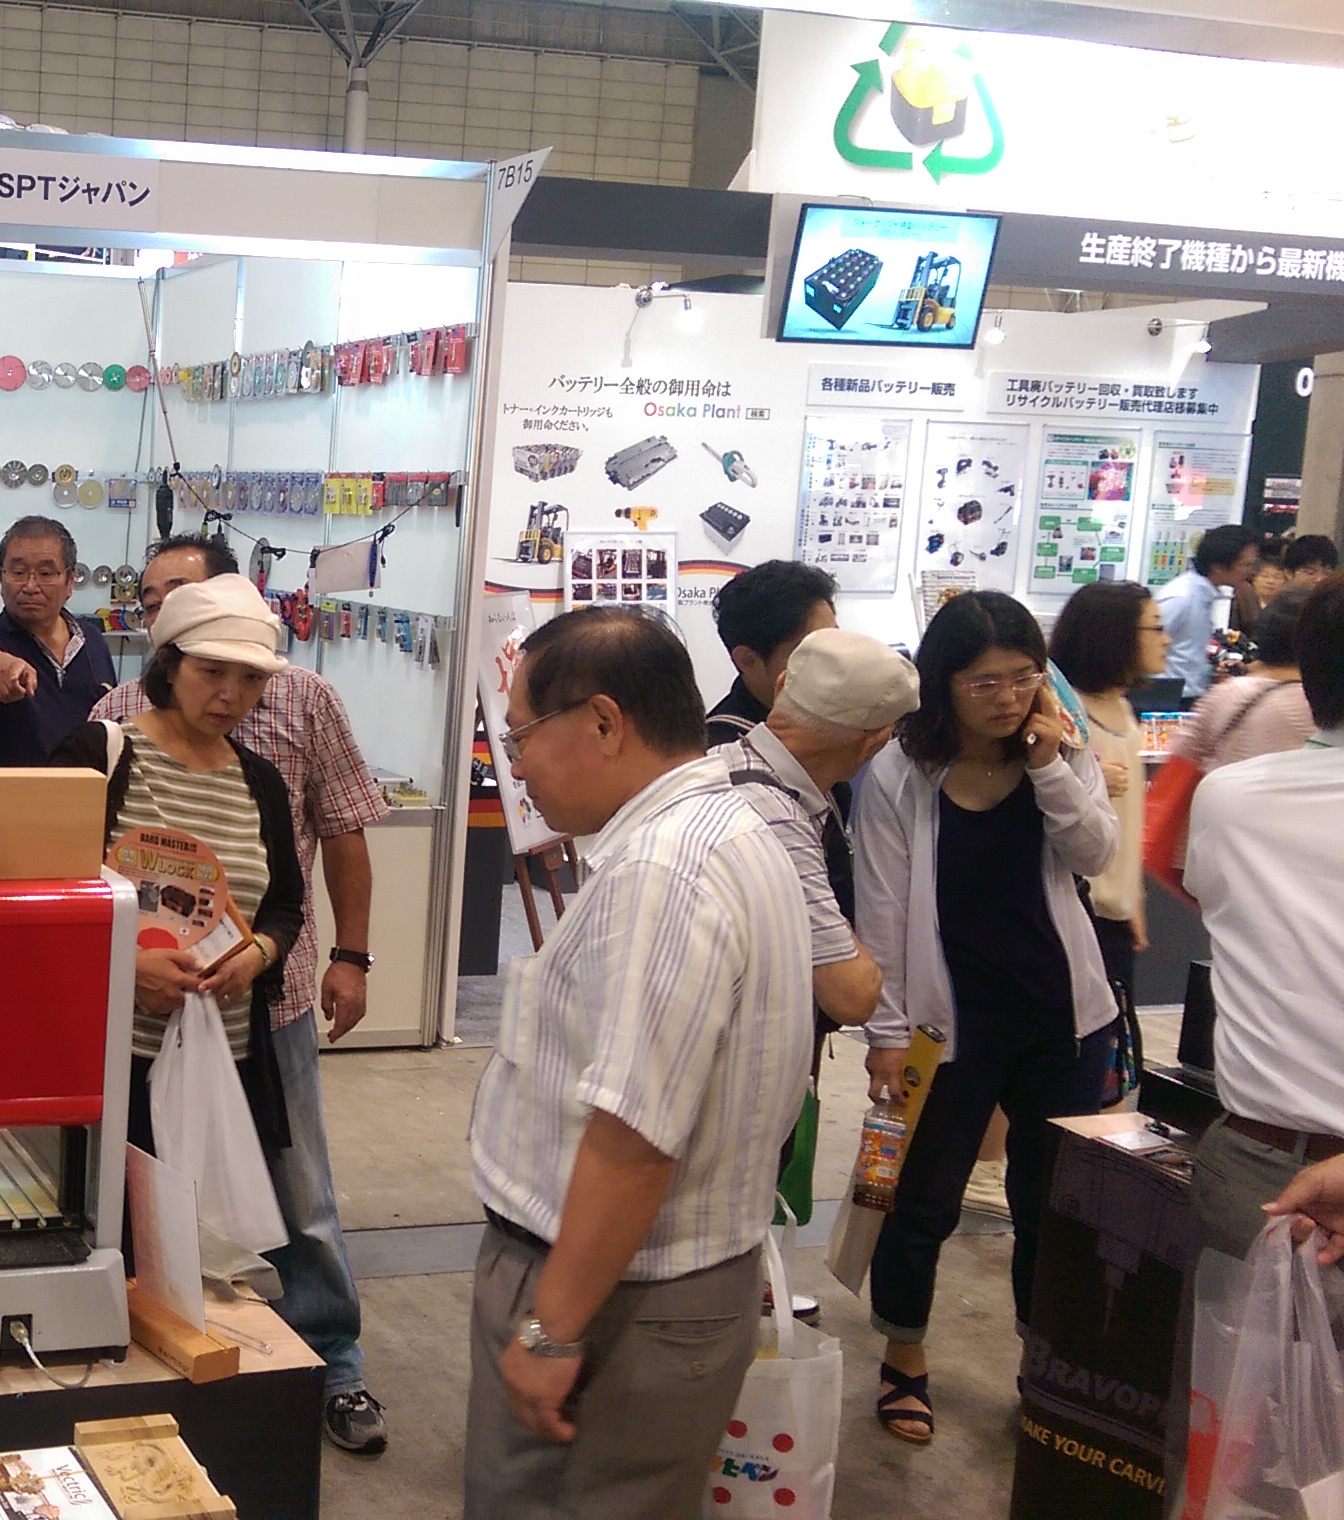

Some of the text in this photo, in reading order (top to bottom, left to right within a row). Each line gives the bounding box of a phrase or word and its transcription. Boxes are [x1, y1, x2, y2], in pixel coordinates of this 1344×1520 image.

[497, 160, 533, 190] 7B15
[548, 375, 733, 397] バッテリー全般の御用命は
[821, 377, 956, 396] 各種新品バッテリー販売
[644, 402, 741, 419] Osaka Plant
[523, 419, 590, 432] 御用命ください。
[1053, 1433, 1106, 1469] YOUR
[56, 1464, 87, 1499] Vectric
